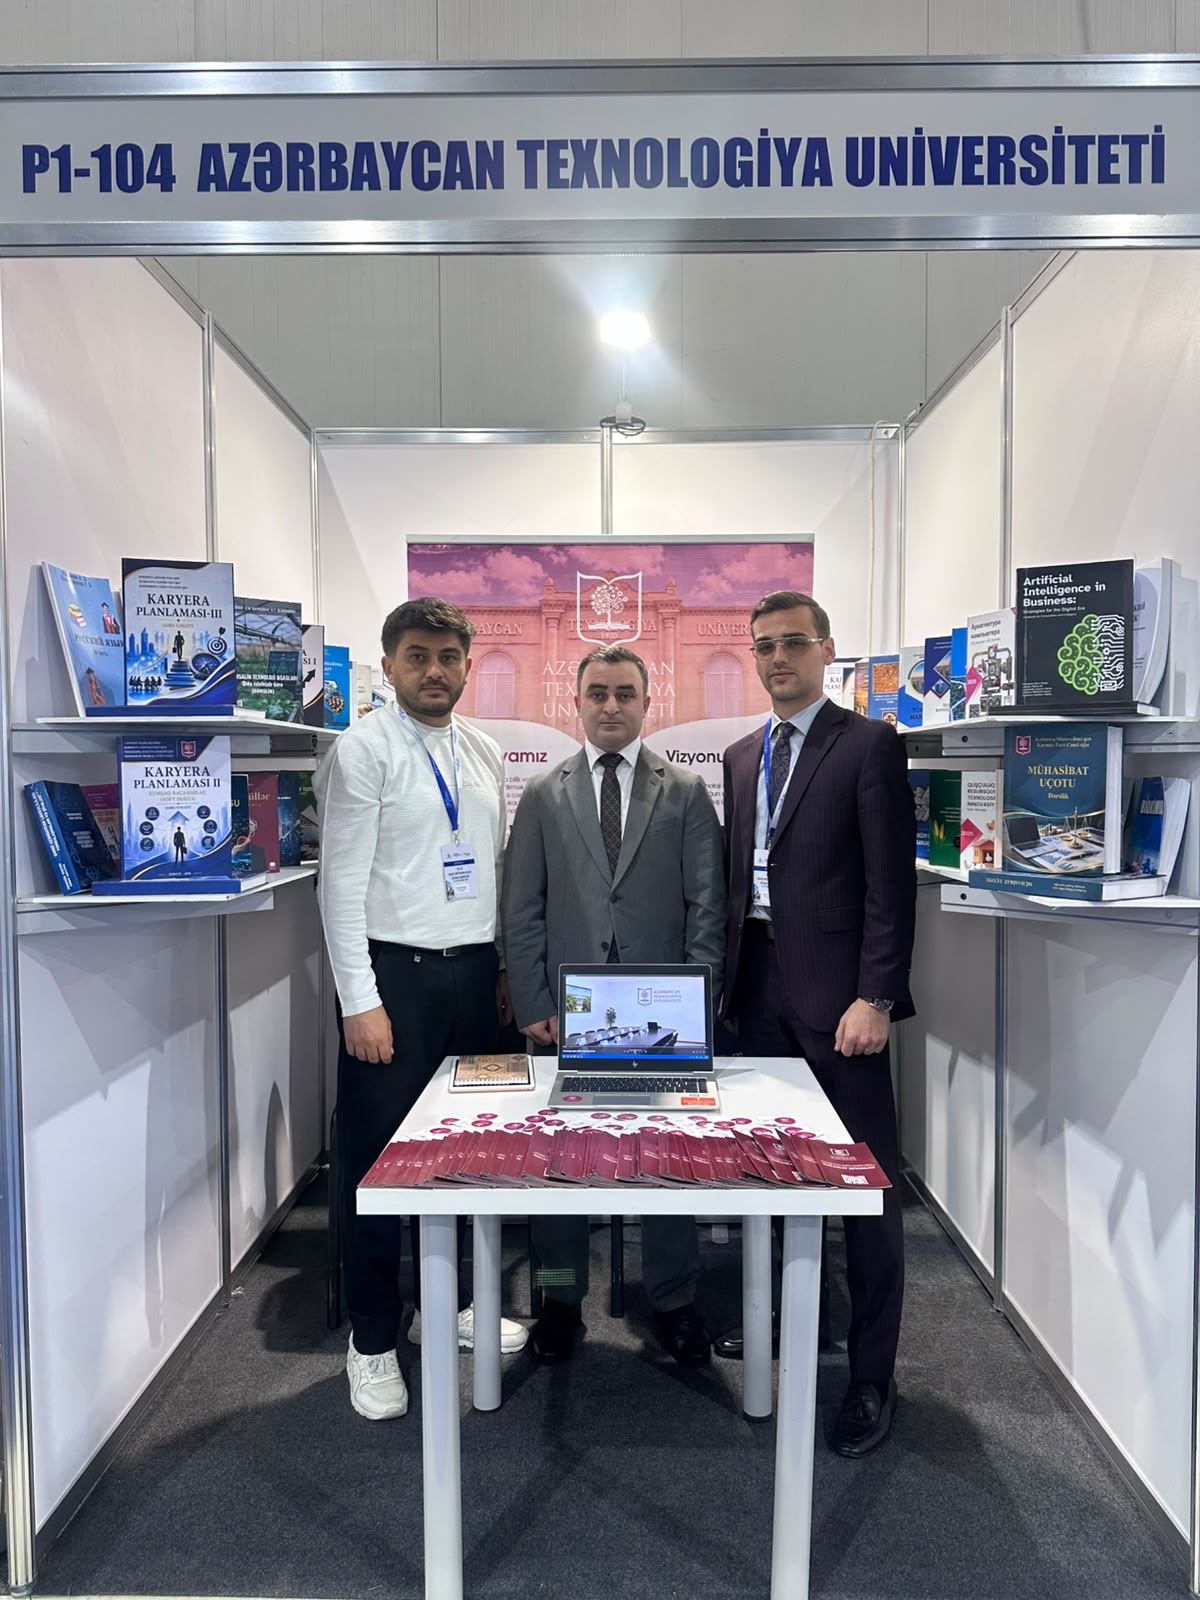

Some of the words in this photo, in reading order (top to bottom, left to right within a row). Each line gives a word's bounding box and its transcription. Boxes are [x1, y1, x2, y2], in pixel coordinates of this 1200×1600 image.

[22, 143, 176, 194] P1-104
[196, 139, 505, 193] AZƏRBAYCAN
[516, 127, 833, 190] TEXNOLOGİYA
[845, 124, 1165, 189] UNİVERSİTETİ
[1023, 574, 1073, 586] Artificial
[1023, 585, 1091, 597] Intelligence
[1094, 581, 1106, 592] in
[147, 593, 210, 606] KARYERA
[1023, 596, 1077, 607] Business:
[136, 606, 222, 619] PLANLAMASI-III
[144, 766, 211, 778] KARYERA
[1027, 764, 1089, 776] MÜHASİBAT
[134, 779, 210, 789] PLANLAMASI
[213, 778, 221, 787] II
[1040, 778, 1076, 789] UÇOTU
